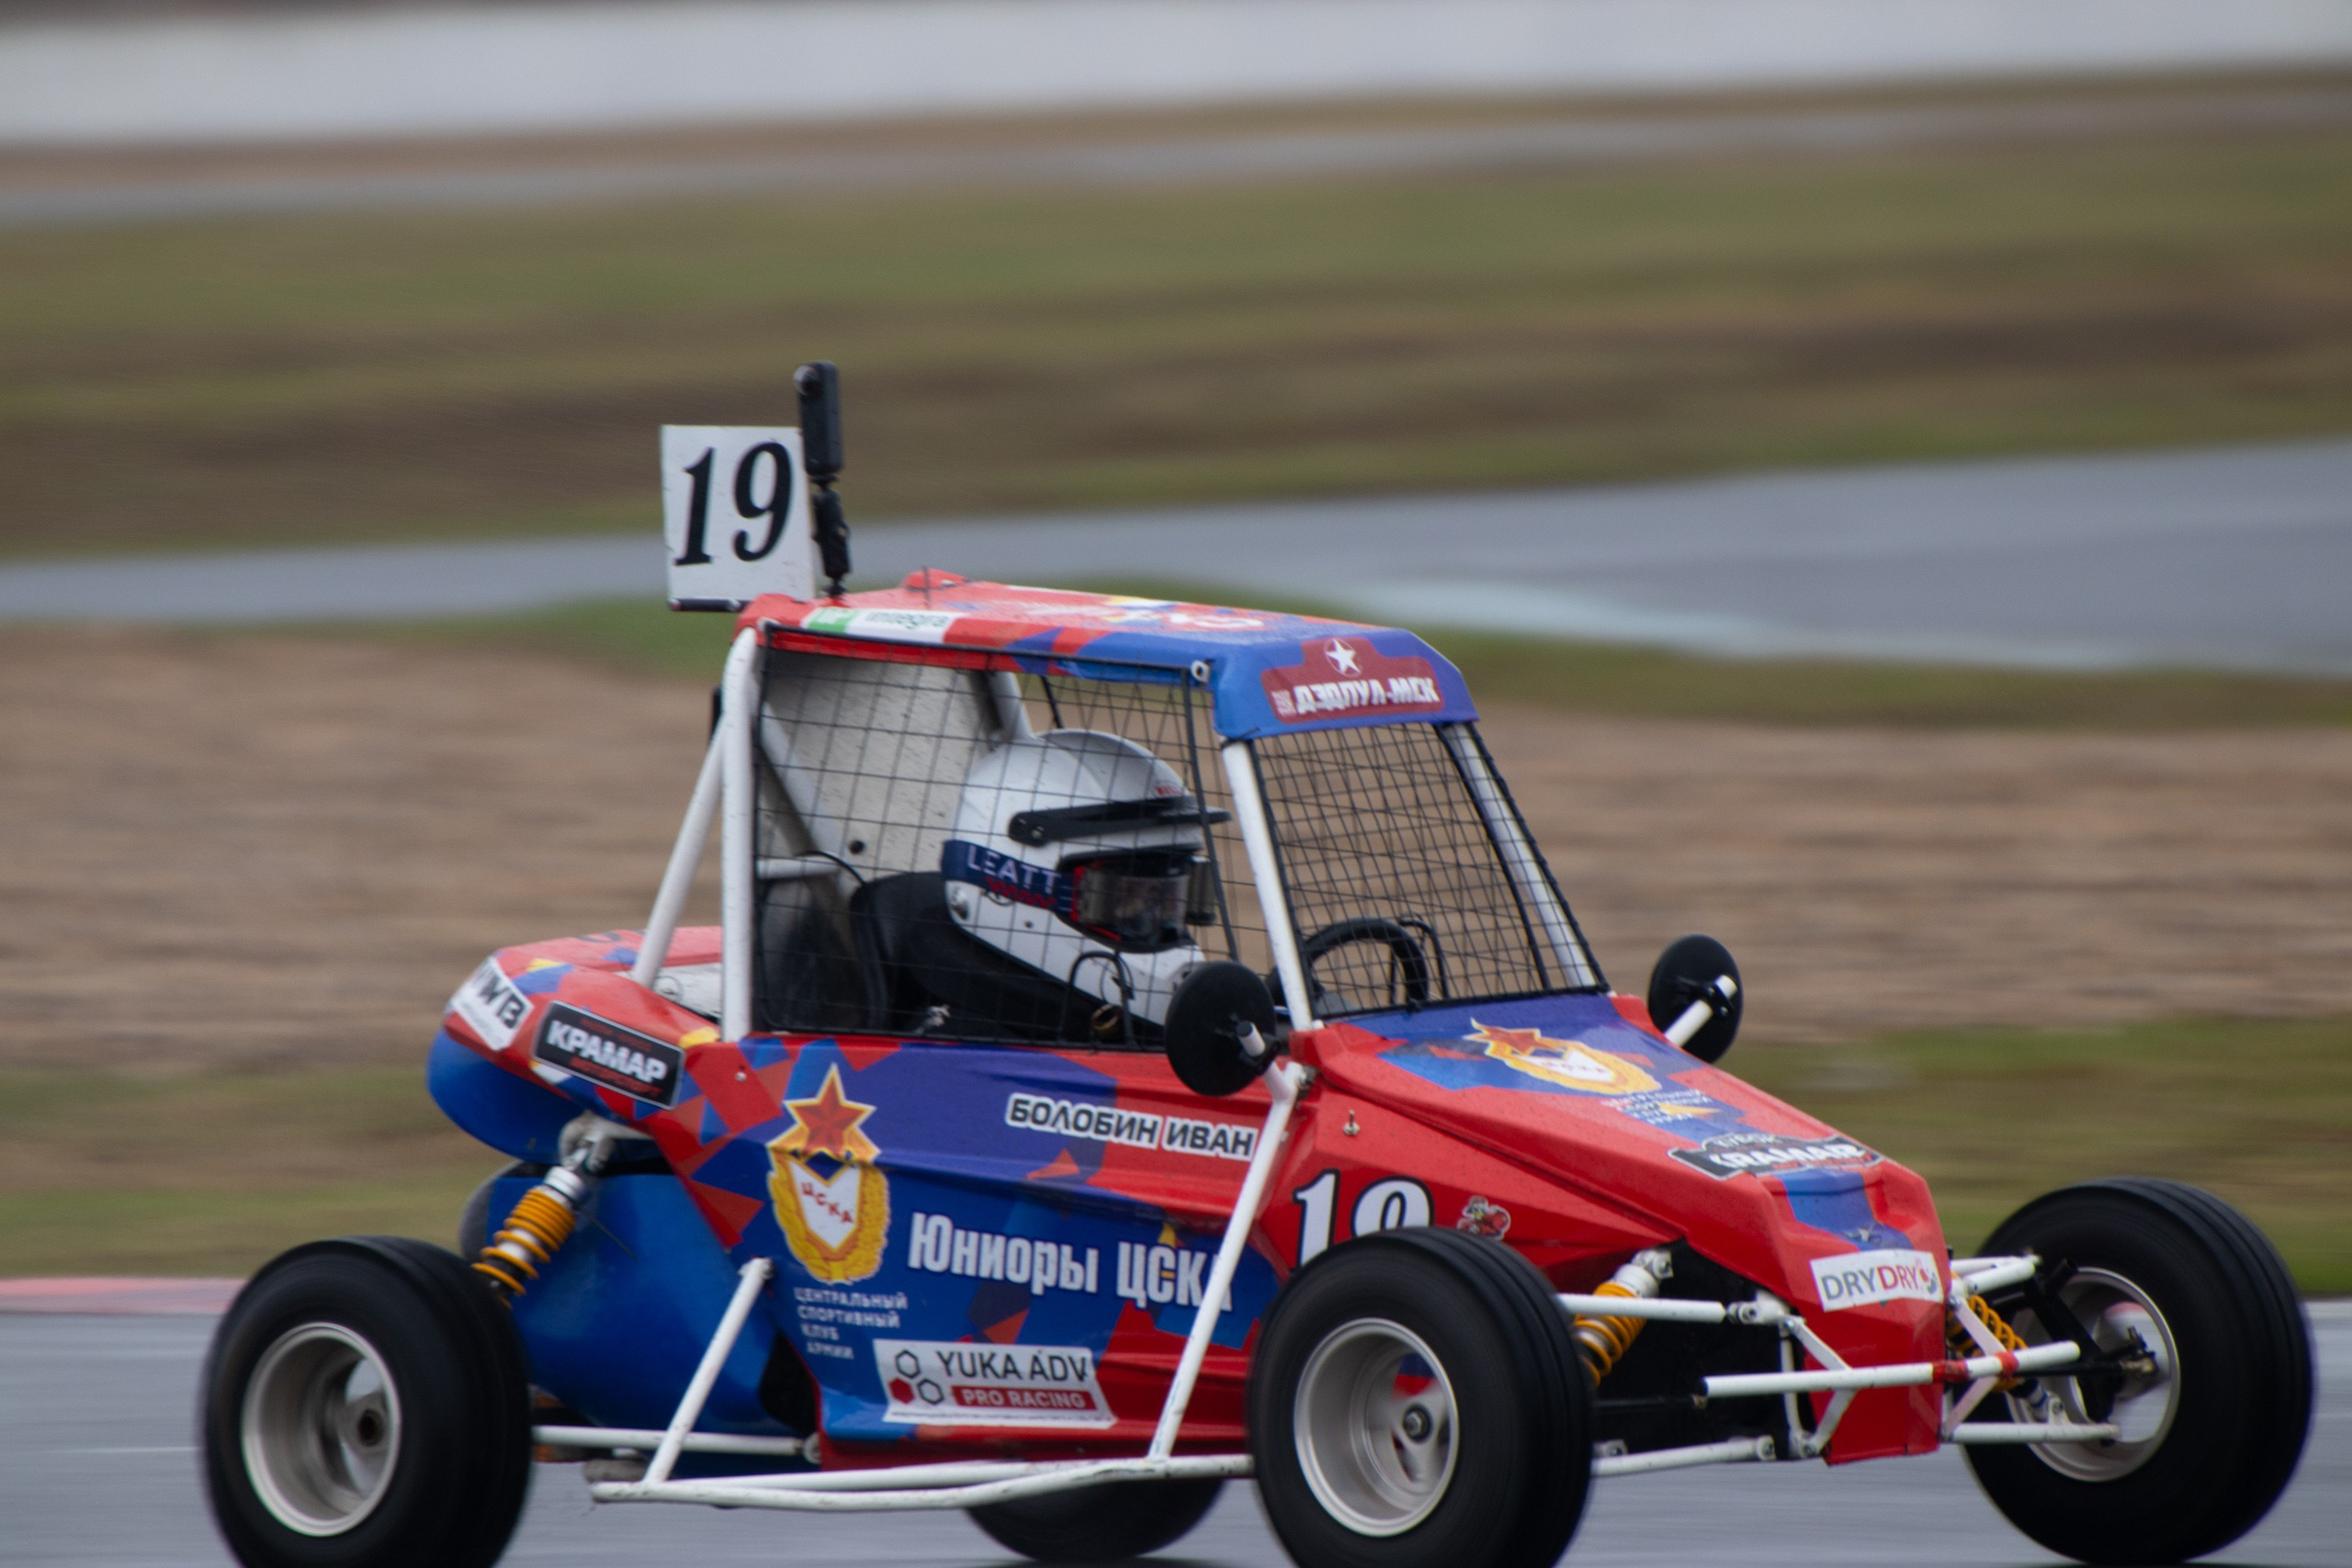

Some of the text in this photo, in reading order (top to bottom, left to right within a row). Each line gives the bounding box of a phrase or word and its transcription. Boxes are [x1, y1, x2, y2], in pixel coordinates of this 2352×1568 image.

[673, 441, 793, 566] 19
[967, 844, 1061, 895] LEATT
[546, 1020, 668, 1083] КРАМАР
[1010, 1098, 1255, 1156] БОЛОБИН ИВАН
[908, 1212, 1099, 1295] Юниоры
[936, 1349, 1087, 1382] YUKA ADV
[963, 1388, 1086, 1409] PRO RACING
